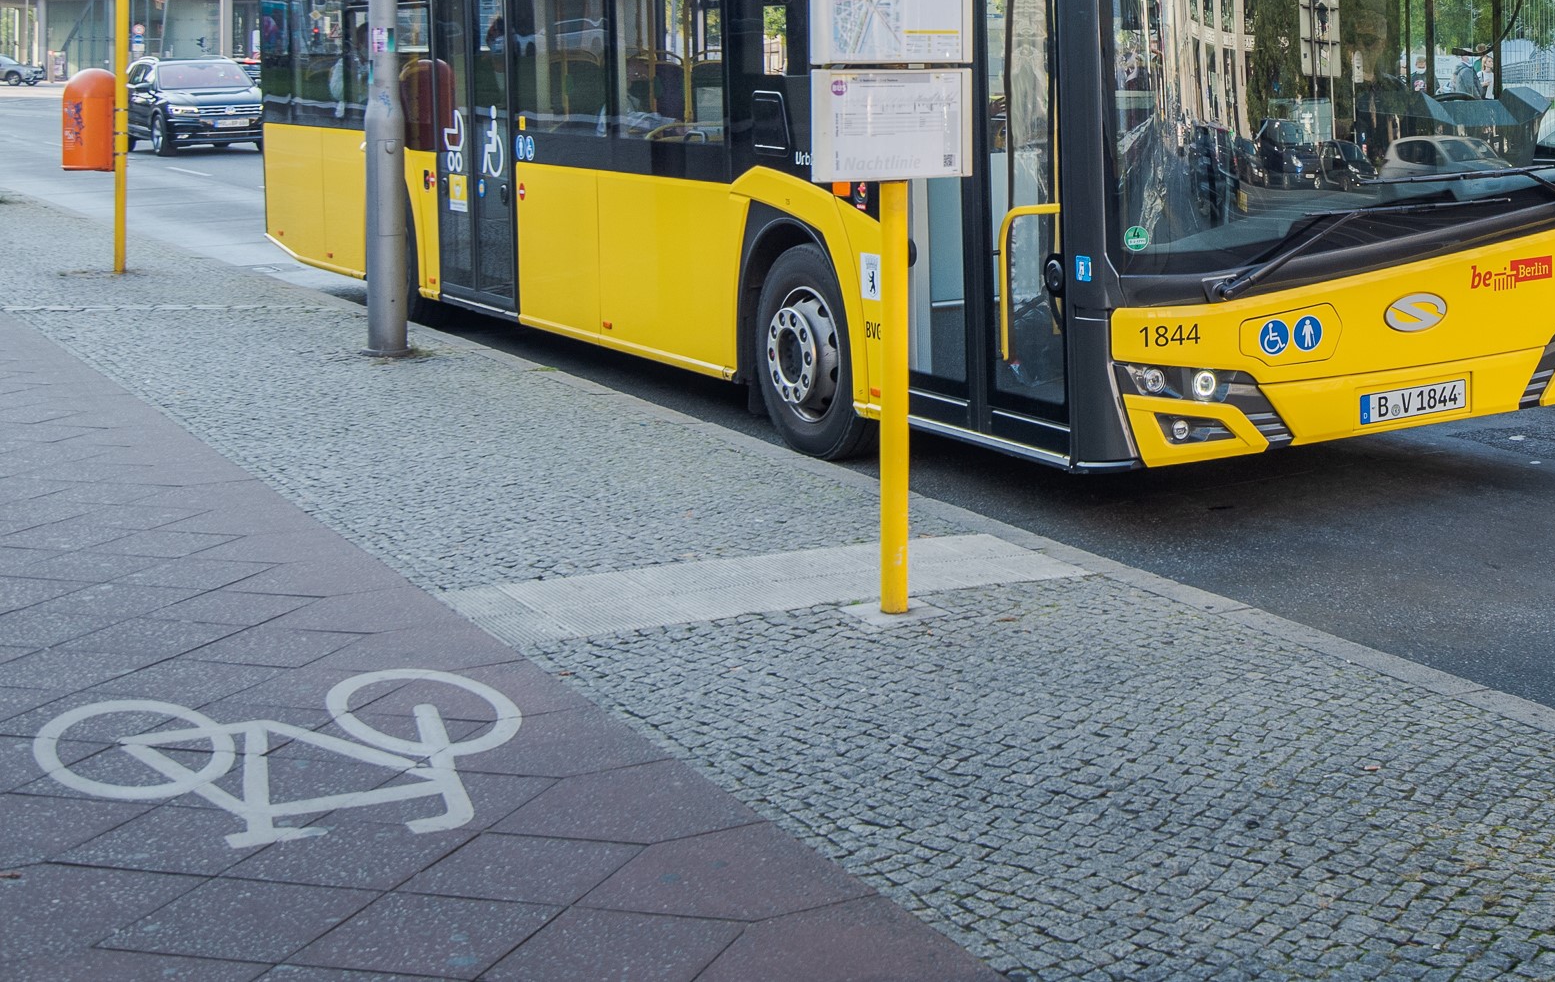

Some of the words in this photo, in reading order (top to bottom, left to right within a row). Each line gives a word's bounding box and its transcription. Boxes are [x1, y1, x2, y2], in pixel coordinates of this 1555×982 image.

[843, 155, 921, 171] Nachtlinie
[1132, 227, 1140, 238] 4
[1471, 265, 1492, 289] be
[1518, 262, 1549, 278] Berlin
[1139, 323, 1200, 347] 1844
[1378, 396, 1389, 418] B
[1401, 392, 1412, 413] V
[1416, 384, 1458, 411] 1844
